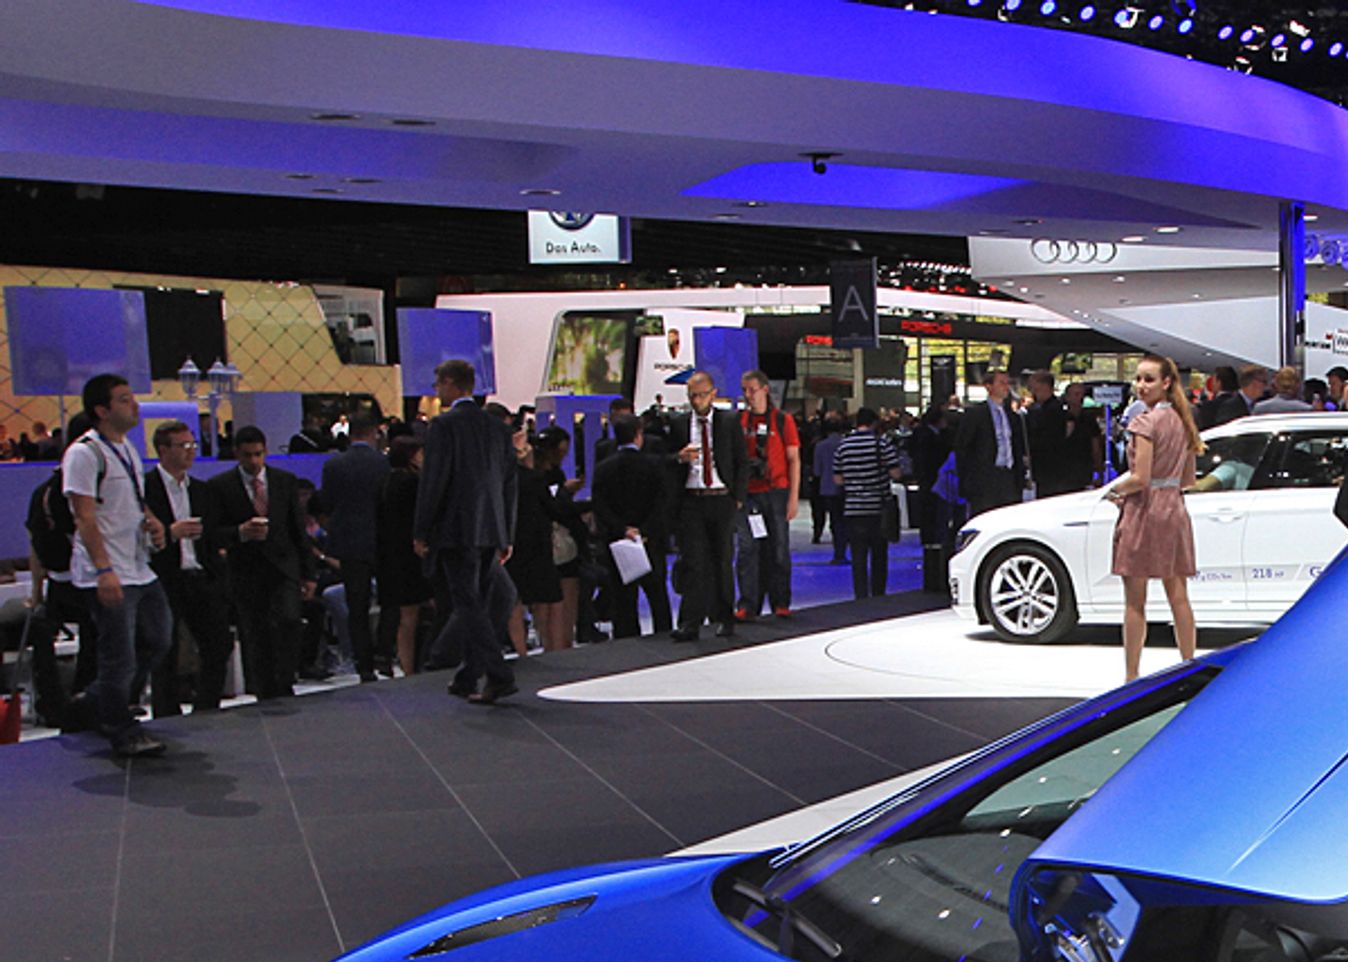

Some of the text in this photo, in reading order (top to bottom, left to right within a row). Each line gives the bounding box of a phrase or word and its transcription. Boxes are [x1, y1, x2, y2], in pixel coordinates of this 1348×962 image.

[546, 241, 601, 253] Das Auto.
[838, 285, 869, 322] A
